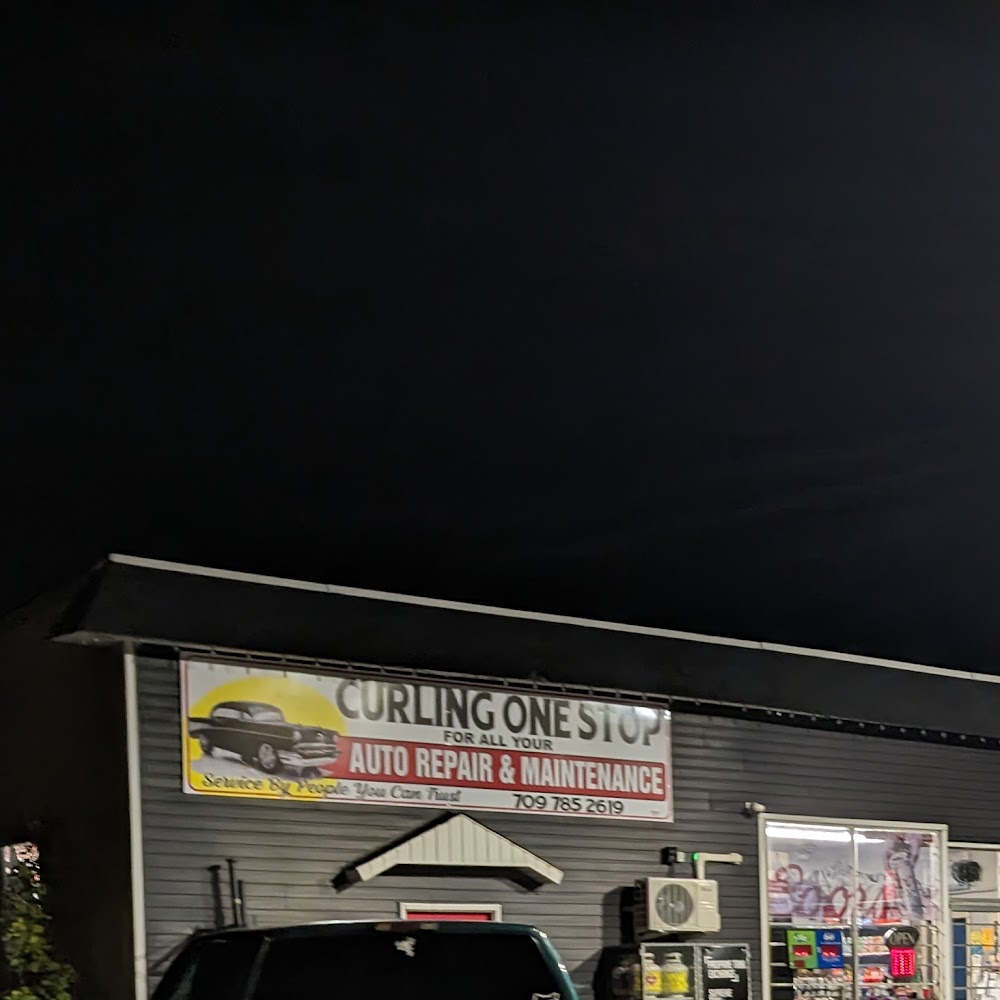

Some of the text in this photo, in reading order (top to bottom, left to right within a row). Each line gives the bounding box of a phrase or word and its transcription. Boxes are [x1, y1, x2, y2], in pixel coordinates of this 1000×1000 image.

[335, 678, 661, 746] CURLING ONE STOP
[443, 731, 554, 751] FOR ALL YOUR
[350, 742, 664, 796] AUTO REPAIR & MAINTENANCE
[202, 772, 462, 802] Service By People You Can Trust
[513, 794, 624, 814] 709 785 2619
